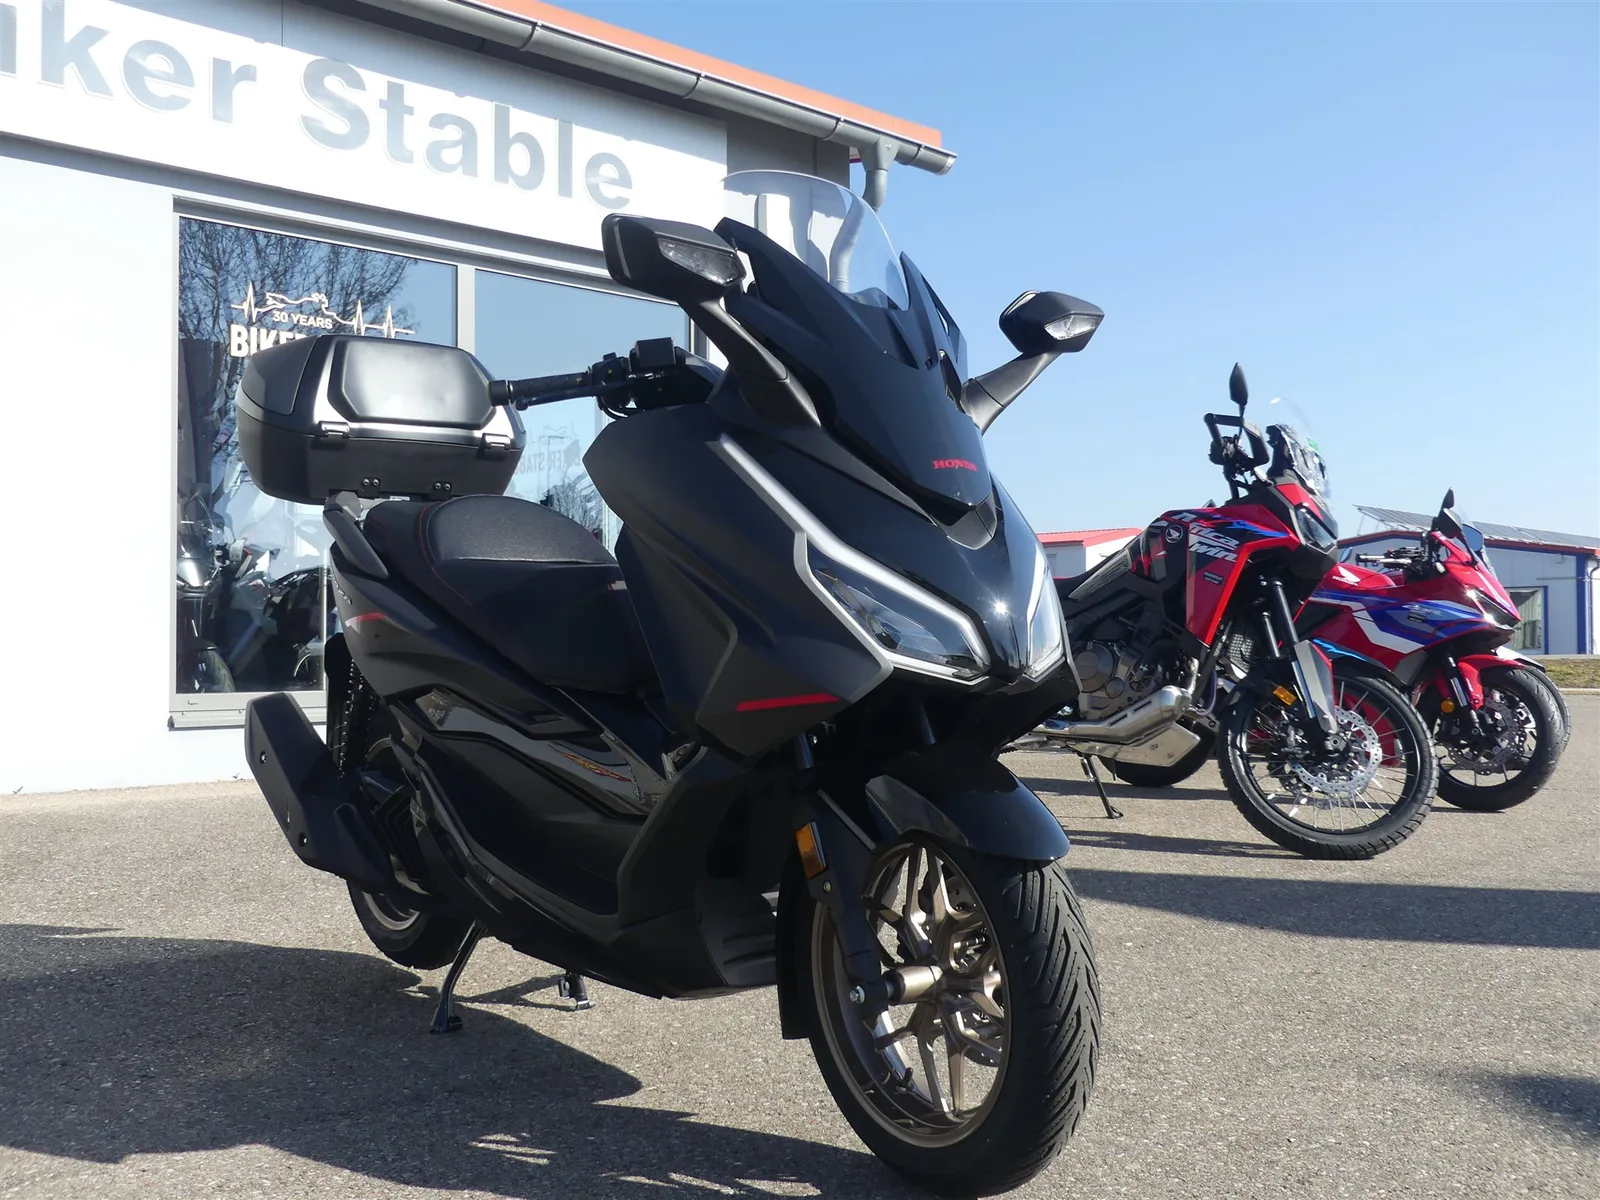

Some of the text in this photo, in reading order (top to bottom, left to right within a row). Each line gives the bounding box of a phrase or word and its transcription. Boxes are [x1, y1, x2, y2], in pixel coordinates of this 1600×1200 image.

[300, 57, 633, 210] Stable
[273, 311, 333, 329] 30 YEARS
[230, 324, 307, 357] BIK
[932, 459, 978, 472] HONDA
